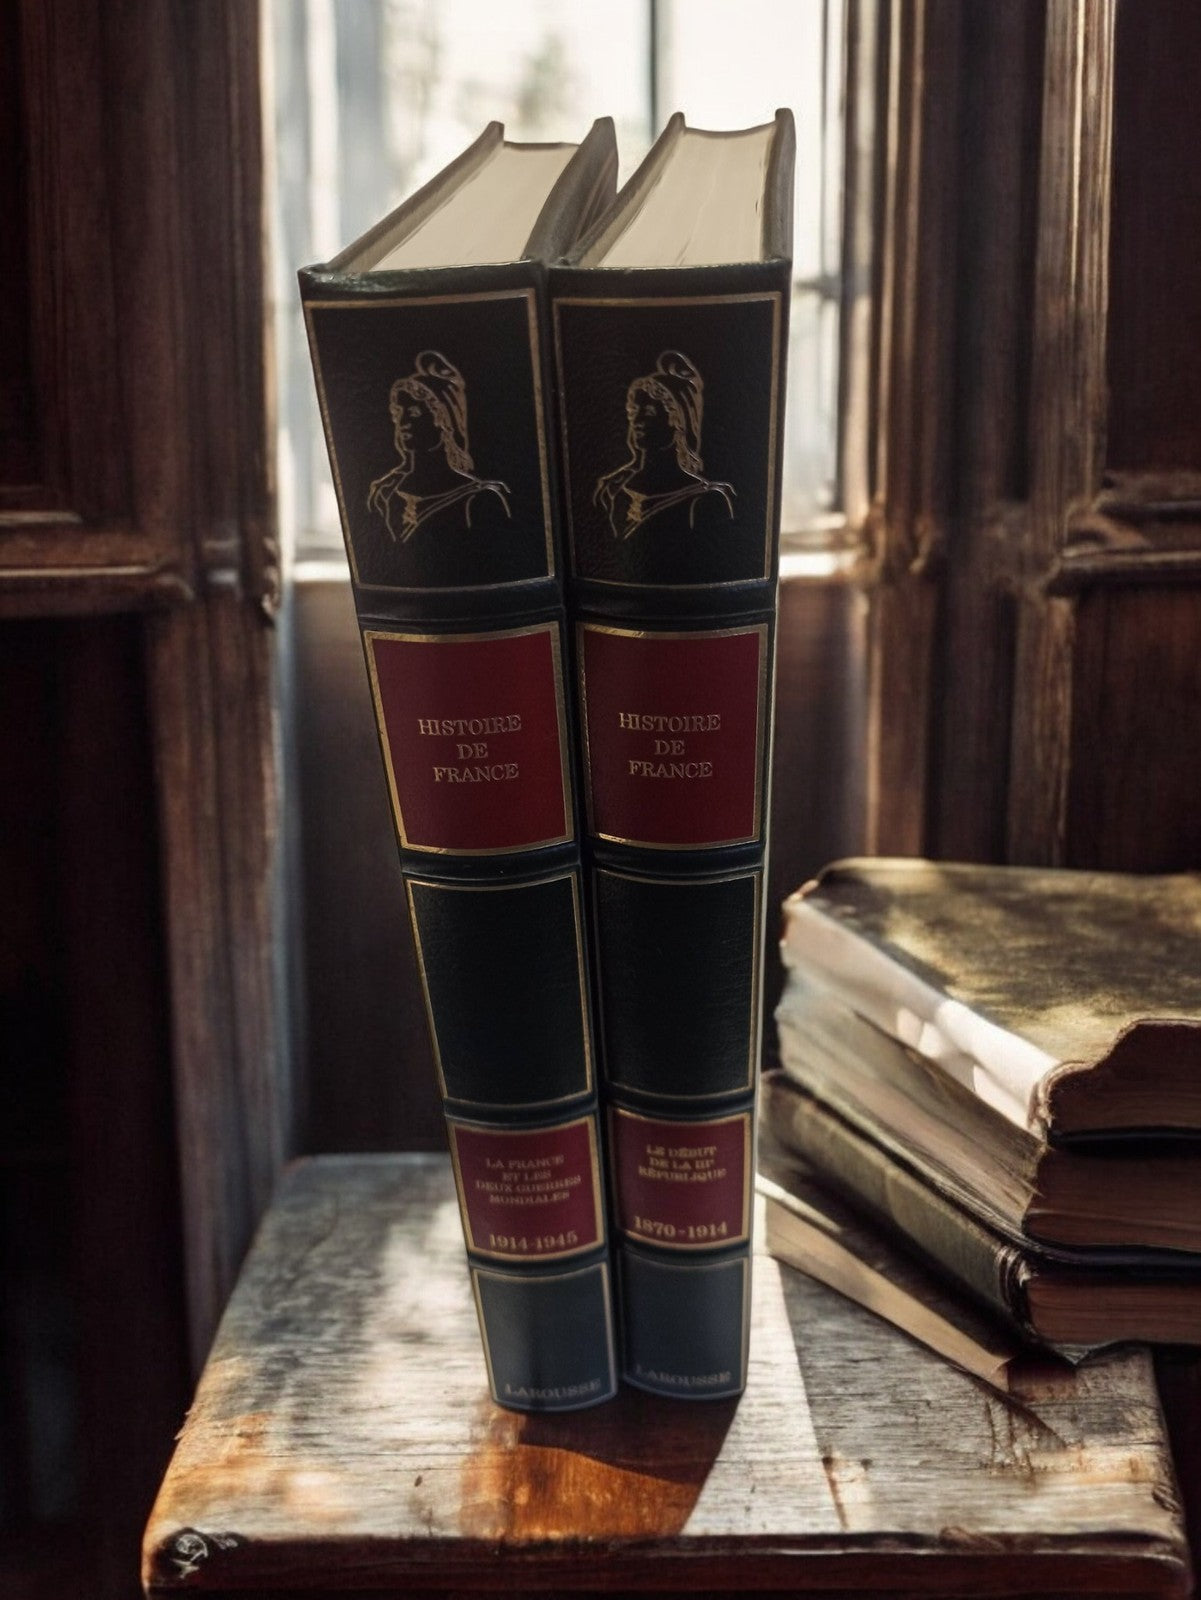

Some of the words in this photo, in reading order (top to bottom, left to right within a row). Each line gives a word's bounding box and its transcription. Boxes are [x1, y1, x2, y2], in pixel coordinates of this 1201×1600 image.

[417, 714, 522, 736] HISTOIRE
[618, 711, 721, 733] HISTOIRE
[457, 742, 489, 760] DE
[654, 739, 686, 756] DE
[432, 762, 520, 783] FRANCE
[628, 759, 713, 779] FRANCE
[485, 1157, 504, 1169] LA
[508, 1154, 564, 1169] FRANCE
[475, 1179, 512, 1192] DEUX
[502, 1171, 520, 1182] ET
[524, 1169, 552, 1181] LES
[634, 1364, 731, 1386] LAROUSSE
[504, 1378, 601, 1399] LAROUSSE
